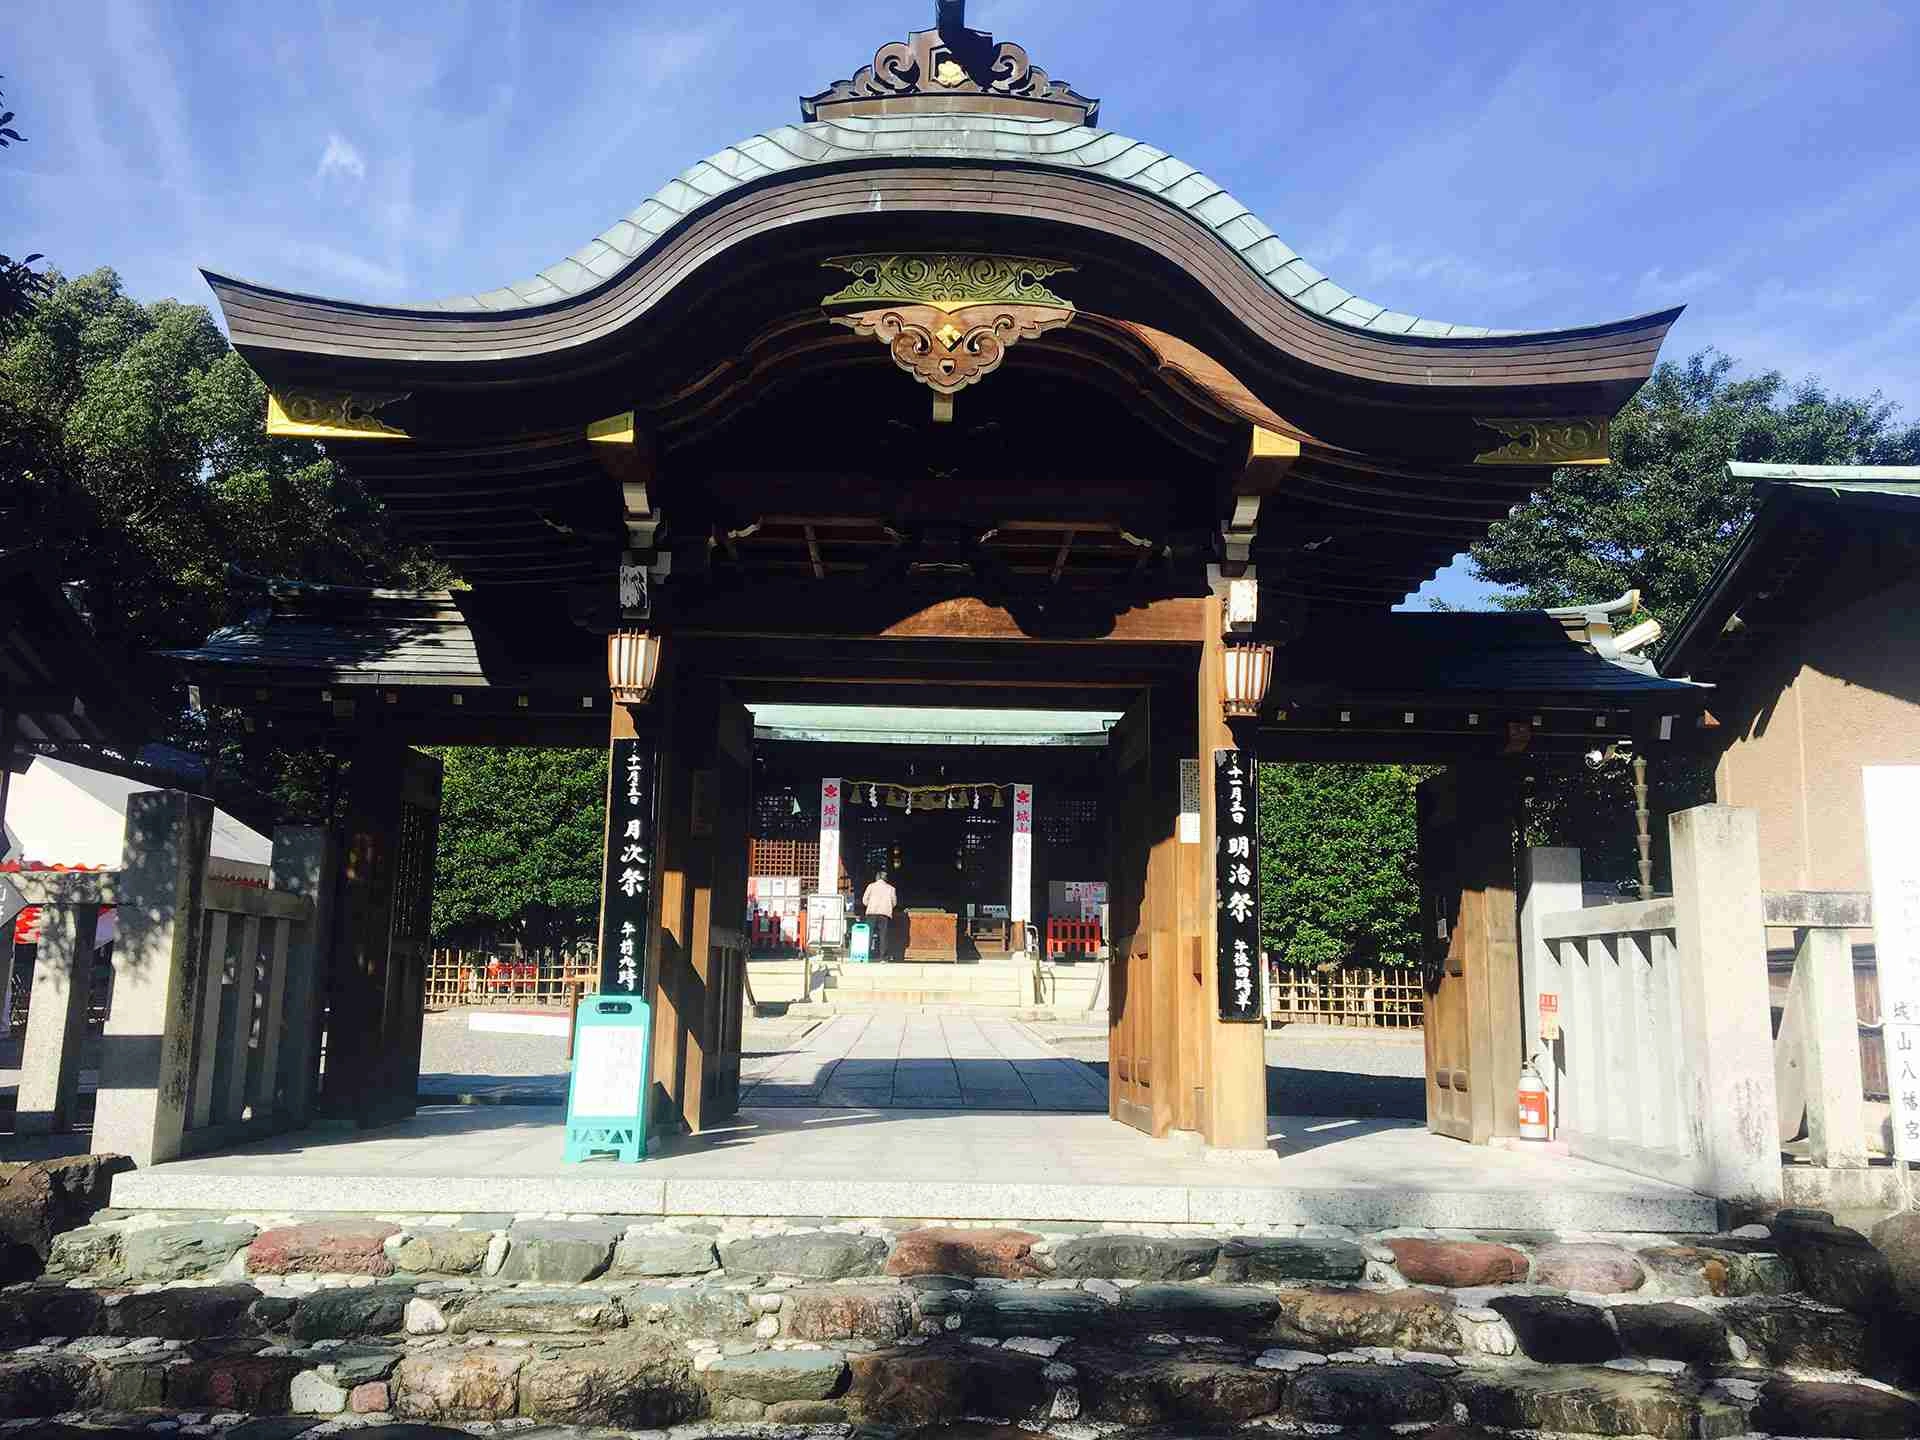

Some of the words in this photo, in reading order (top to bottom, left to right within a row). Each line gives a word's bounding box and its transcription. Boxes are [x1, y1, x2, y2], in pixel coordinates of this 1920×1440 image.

[627, 754, 643, 805] 十一月十五日
[1227, 765, 1247, 825] 十一月三日
[618, 818, 647, 897] 月次祭
[1226, 835, 1255, 924] 明治祭
[616, 921, 639, 992] 午前九時
